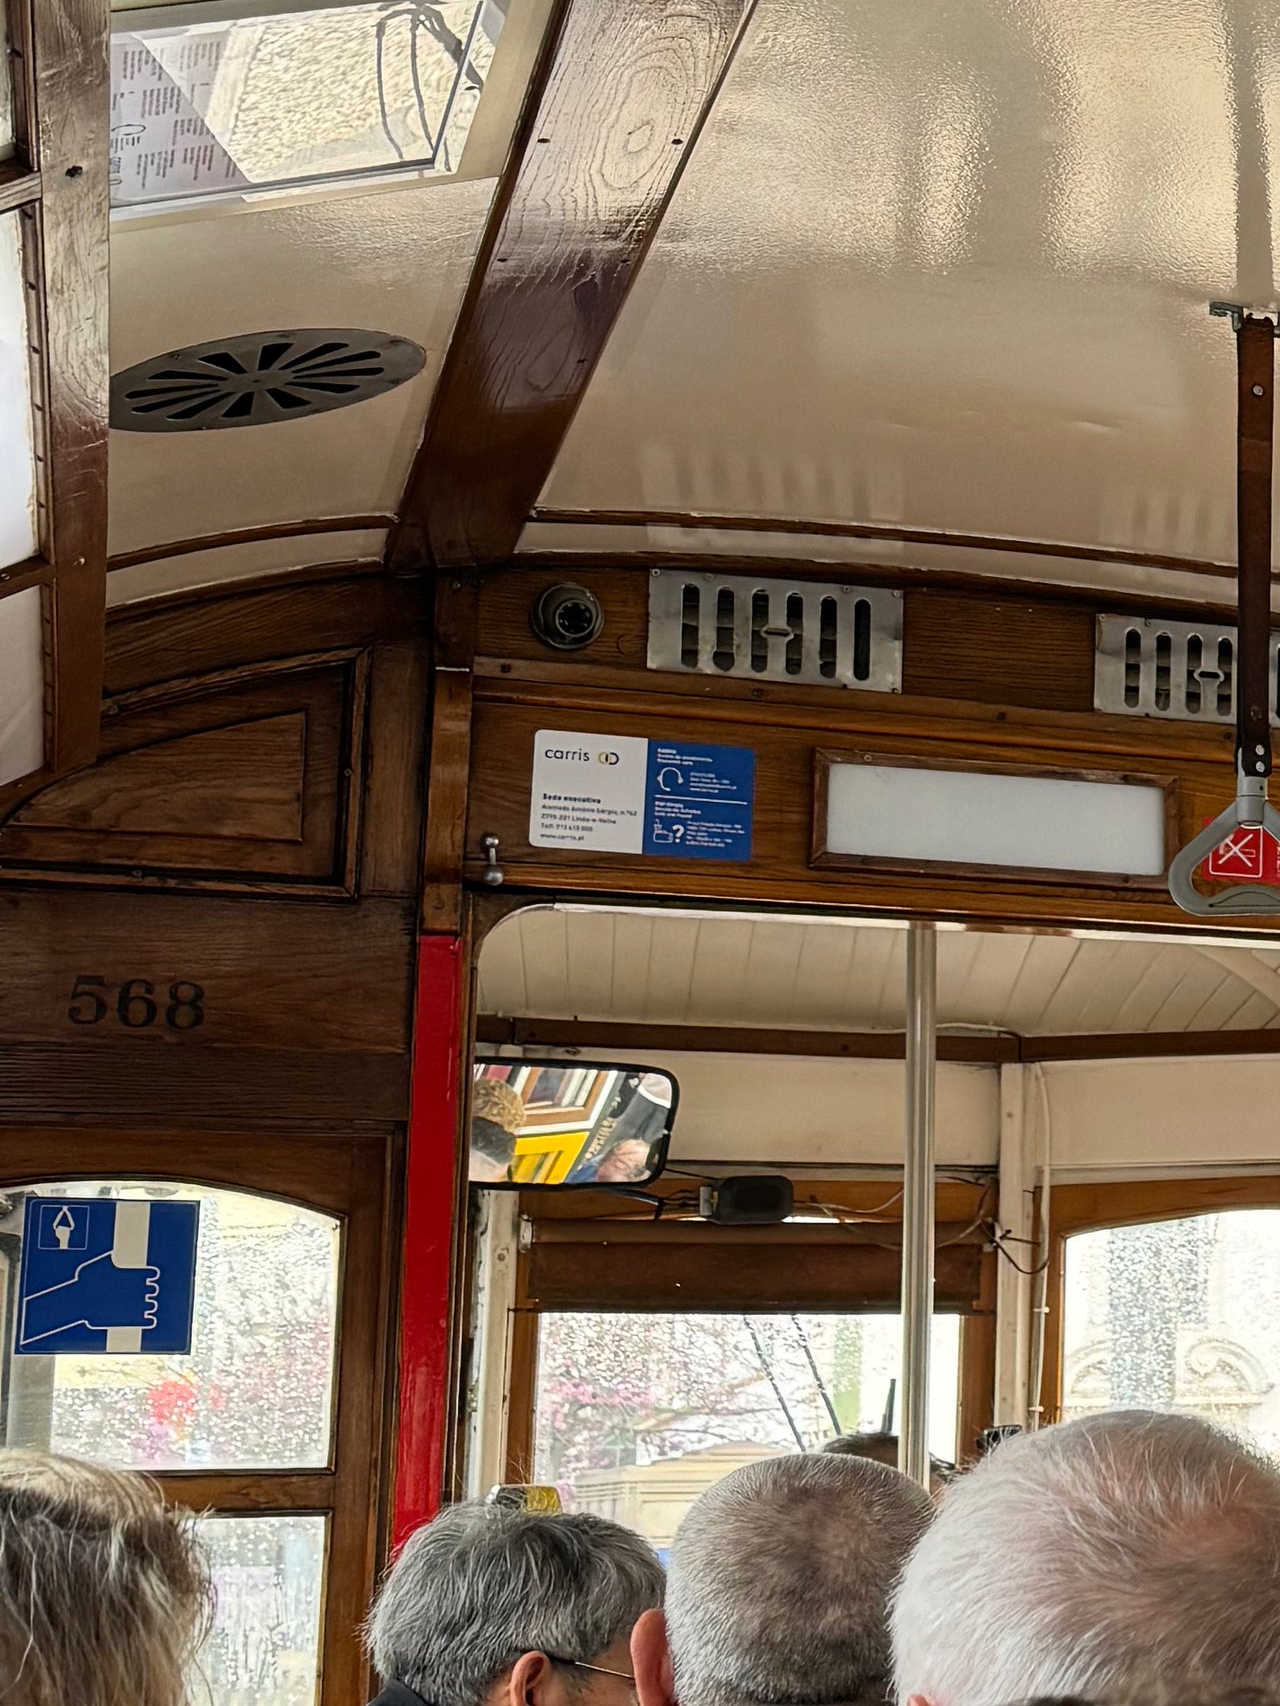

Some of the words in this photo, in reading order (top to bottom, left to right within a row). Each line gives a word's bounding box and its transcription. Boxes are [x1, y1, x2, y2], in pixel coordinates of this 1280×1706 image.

[545, 748, 590, 762] carris
[543, 793, 562, 801] Sede
[564, 796, 601, 804] executiva
[68, 975, 204, 1030] 568
